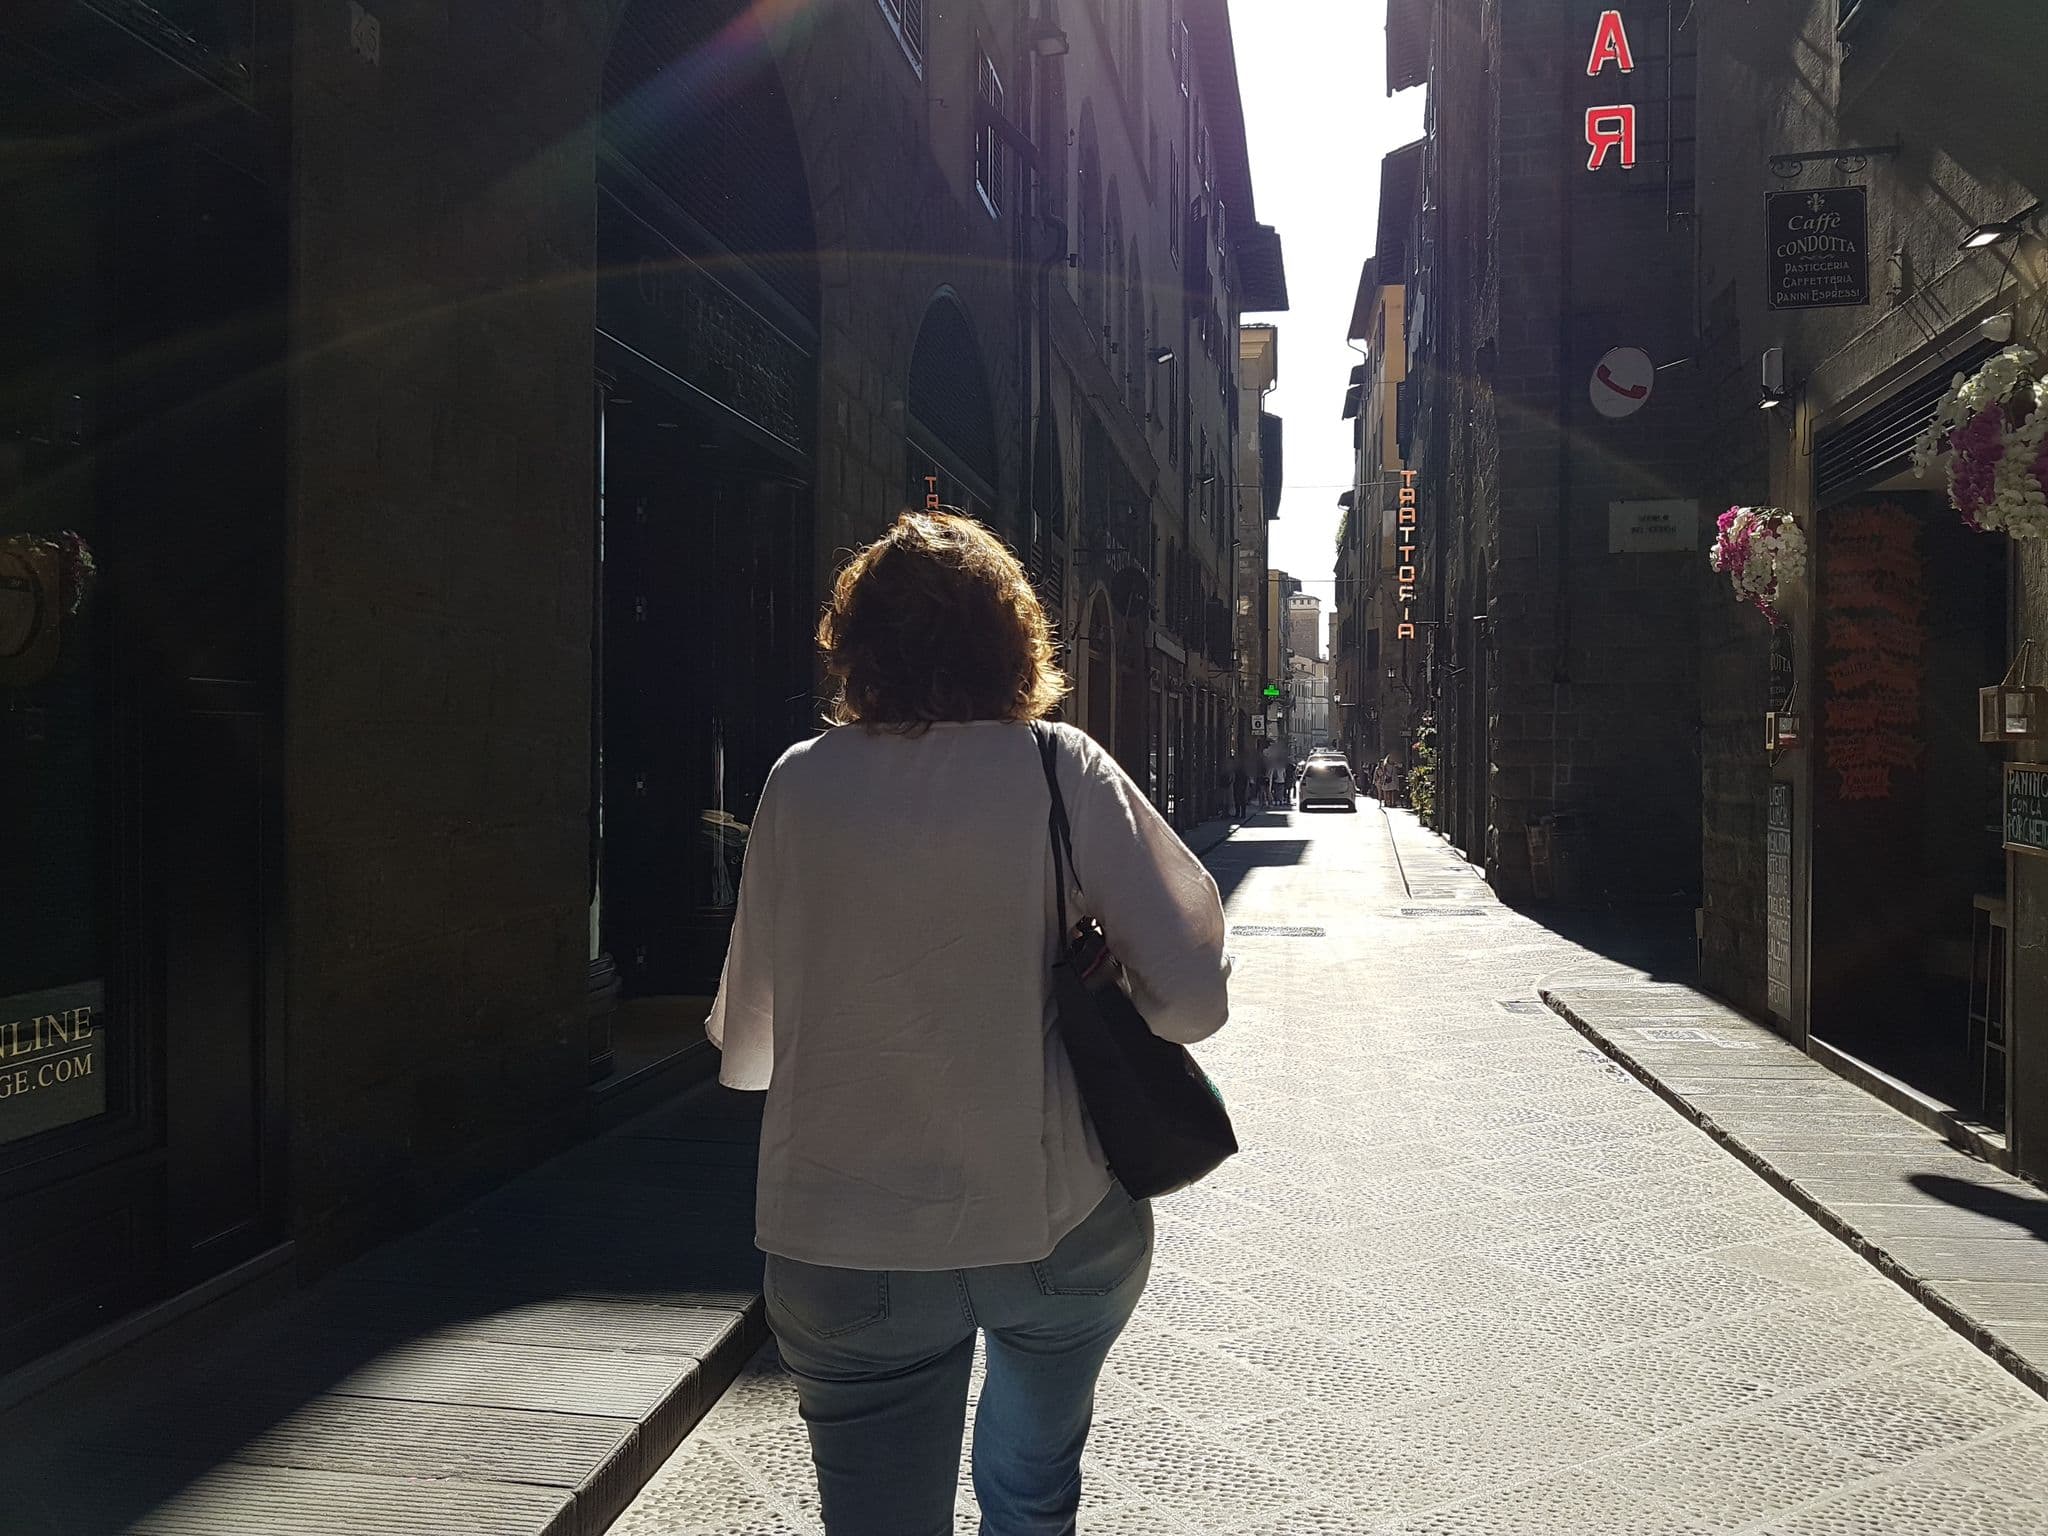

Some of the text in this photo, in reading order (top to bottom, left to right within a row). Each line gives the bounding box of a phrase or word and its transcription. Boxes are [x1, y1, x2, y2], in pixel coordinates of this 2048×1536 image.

[1787, 211, 1841, 234] Caffè
[1776, 235, 1857, 258] CONDOTTA
[1776, 291, 1810, 304] PANINI
